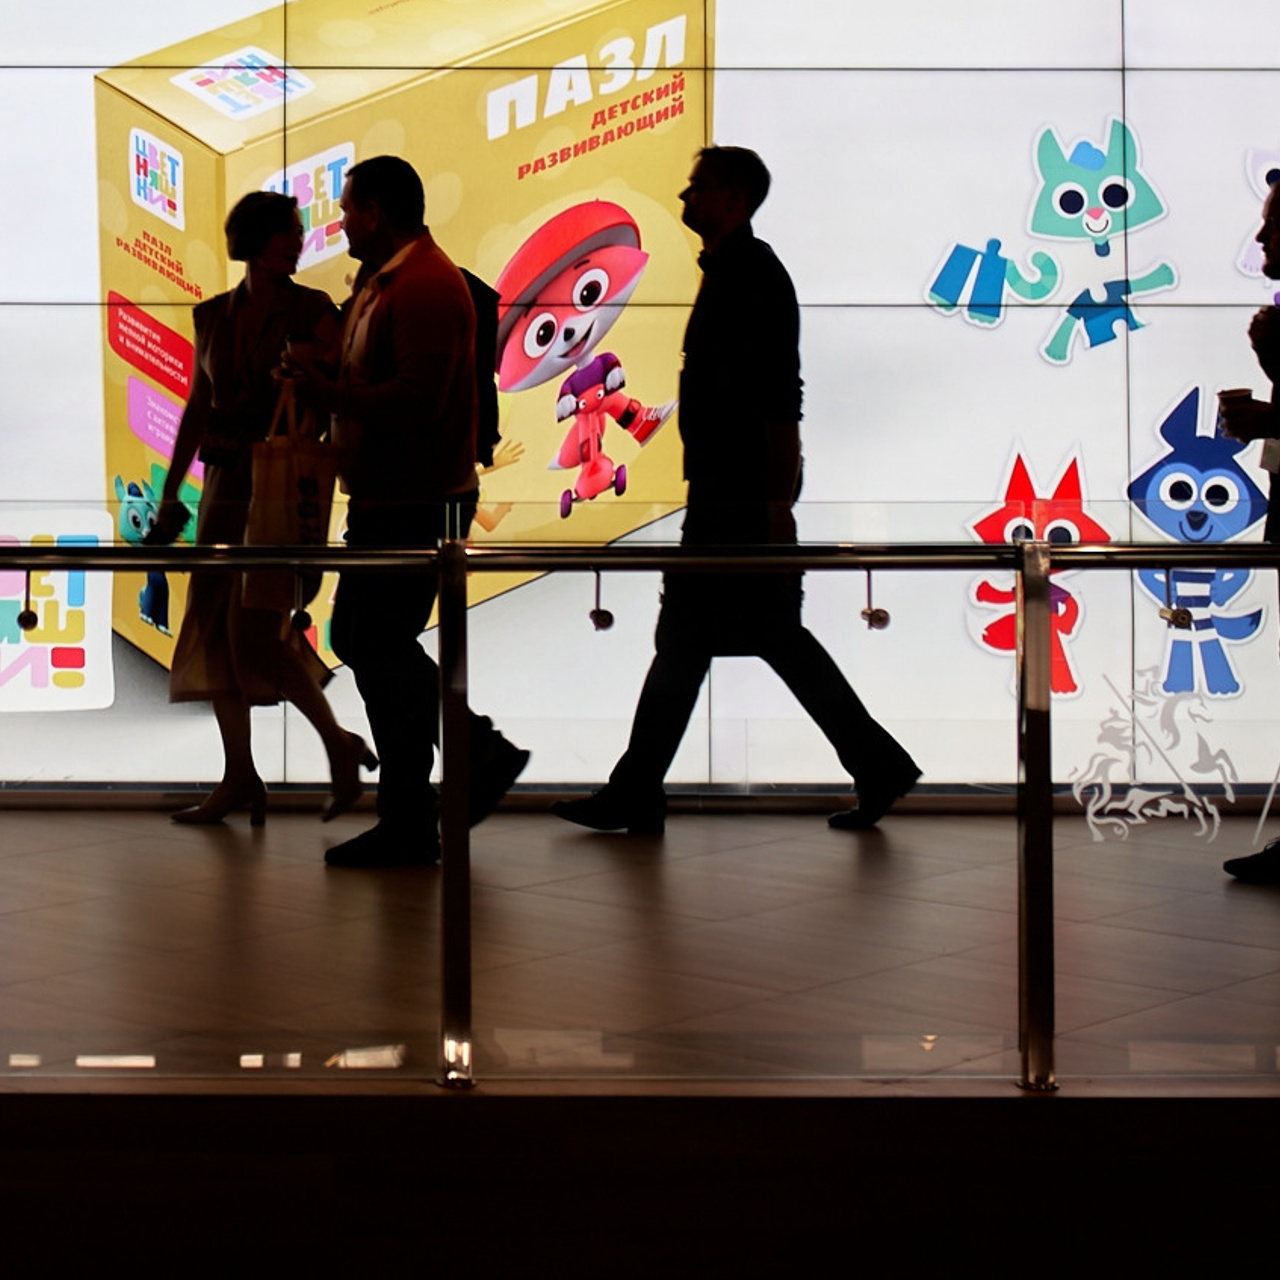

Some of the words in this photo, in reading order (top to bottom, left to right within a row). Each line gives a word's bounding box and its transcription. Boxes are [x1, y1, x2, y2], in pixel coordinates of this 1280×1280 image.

[486, 14, 687, 140] ПАЗЛ
[591, 72, 685, 130] ДЕТСКИЙ
[135, 135, 180, 186] ЦВЕТ
[518, 95, 685, 180] РАЗВИВАЮЩИЙ
[270, 156, 348, 207] ВЕТ
[116, 237, 203, 300] РАЗВИВАЮЩИЙ
[134, 238, 184, 277] ДЕТСКИЙ
[142, 230, 172, 257] ПАЗЛ
